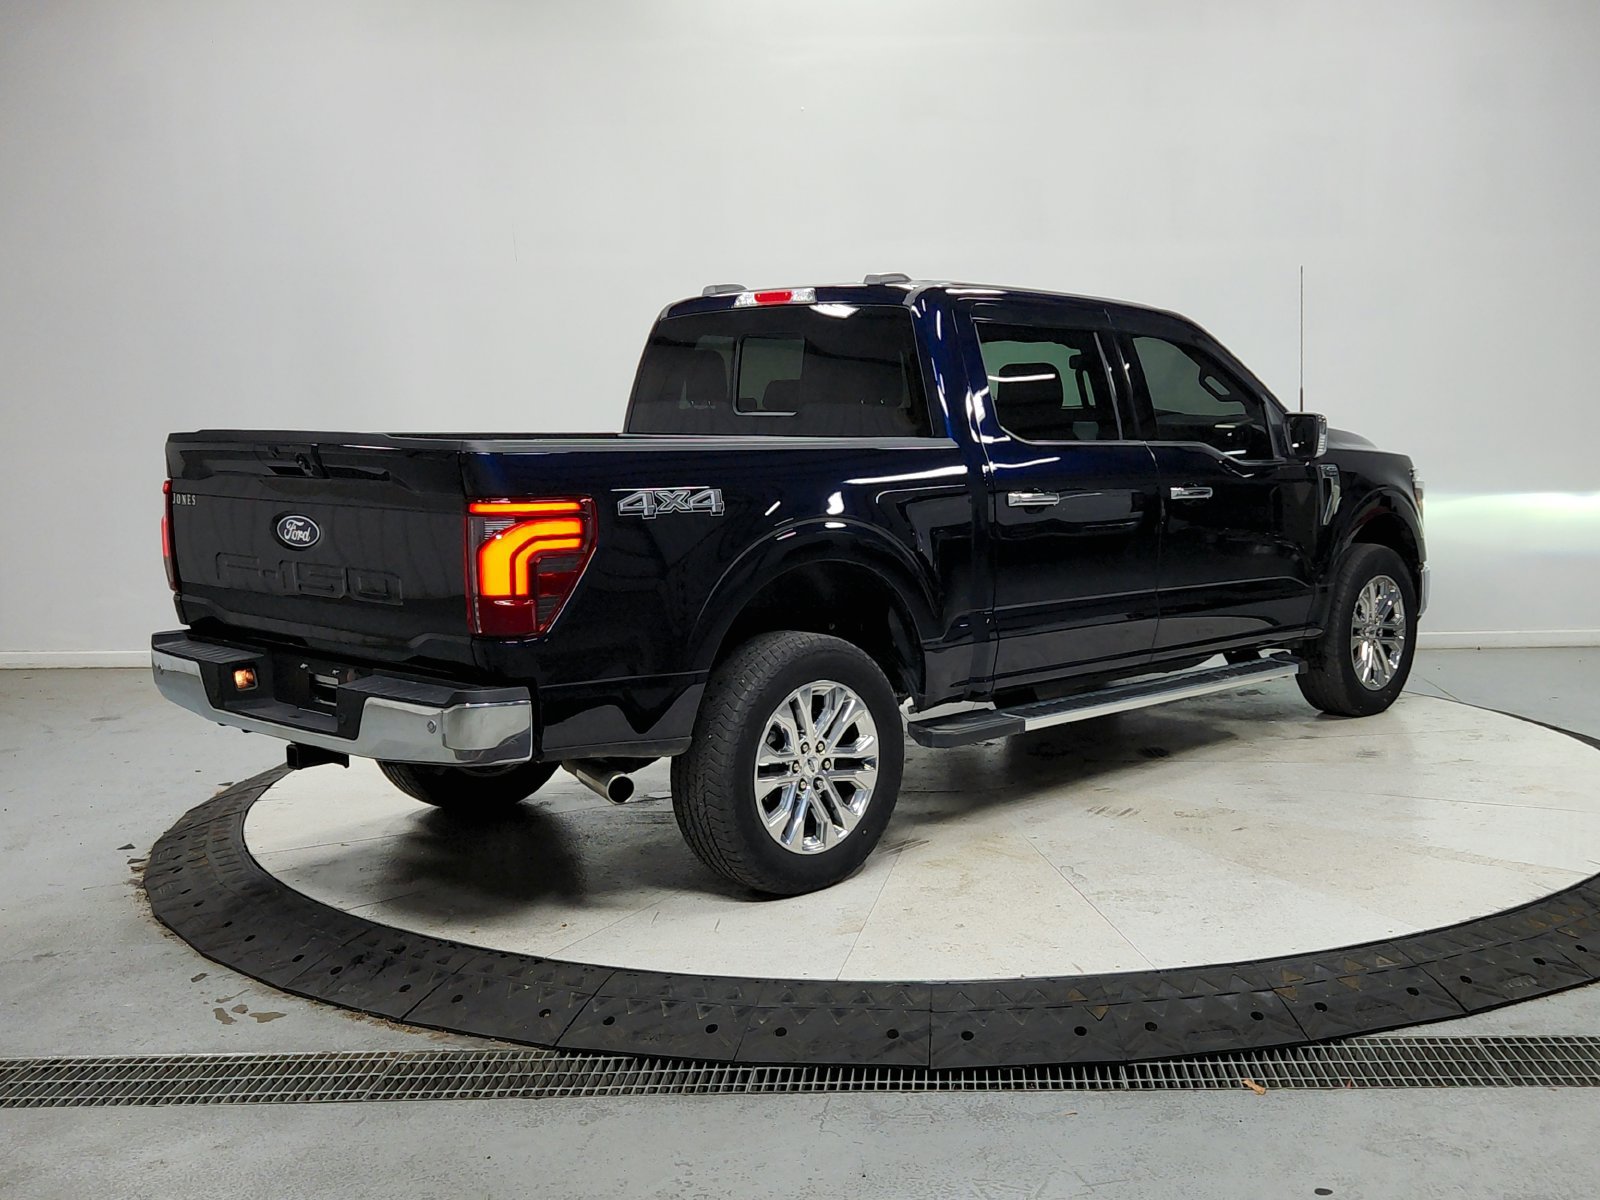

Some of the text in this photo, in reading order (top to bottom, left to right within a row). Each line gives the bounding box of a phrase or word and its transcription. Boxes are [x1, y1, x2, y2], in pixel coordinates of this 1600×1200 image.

[172, 493, 196, 506] JONES
[283, 519, 311, 542] Ford
[215, 551, 404, 606] F-150
